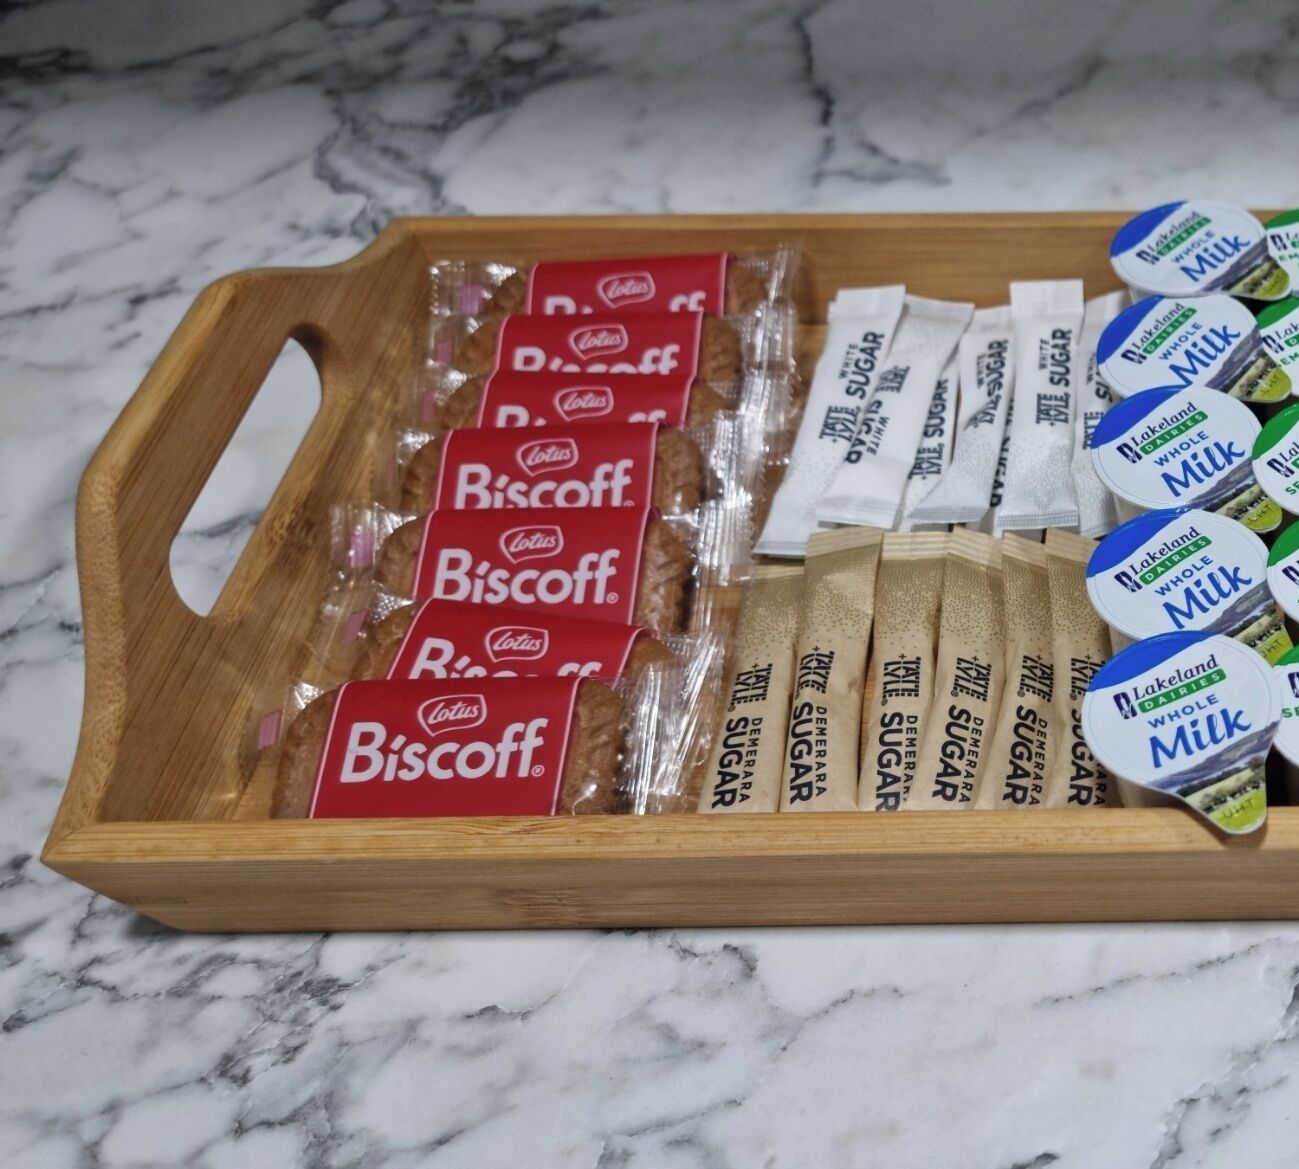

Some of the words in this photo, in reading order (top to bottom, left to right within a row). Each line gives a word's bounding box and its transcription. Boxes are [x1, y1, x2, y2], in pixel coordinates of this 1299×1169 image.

[1148, 211, 1202, 252] Lakeland
[1170, 230, 1217, 264] WHOLE
[1180, 235, 1251, 282] Milk
[607, 277, 650, 300] Lotus
[577, 329, 623, 351] Lotus
[1131, 302, 1186, 351] Lakeland
[1146, 308, 1195, 352] DAIRIES
[1158, 321, 1204, 362] WHOLE
[839, 343, 860, 379] WHITE
[845, 330, 885, 400] SUGAR
[1038, 338, 1050, 371] WHITE
[1048, 328, 1072, 388] SUGAR
[1168, 324, 1241, 386] Milk
[562, 391, 607, 411] Lotus
[1035, 393, 1054, 425] TATE
[866, 415, 891, 456] WHITE
[1131, 402, 1198, 448] Lakeland
[1145, 413, 1205, 453] DAIRIES
[525, 447, 571, 466] Lotus
[1153, 430, 1210, 468] WHOLE
[1160, 441, 1246, 498] Milk
[455, 458, 635, 509] Biscoff
[509, 531, 558, 553] Lotus
[1129, 526, 1202, 577] Lakeland
[1144, 539, 1208, 582] DAIRIES
[1154, 555, 1214, 597] WHOLE
[1162, 565, 1253, 630] Milk
[492, 630, 543, 652] Lotus
[750, 664, 773, 702] TATE
[811, 650, 836, 695] TATE
[900, 656, 921, 698] TATE
[971, 663, 992, 703] TATE
[1036, 663, 1055, 703] TATE
[1132, 653, 1221, 702] Lakeland
[1143, 671, 1222, 711] DAIRIES
[427, 701, 479, 724] Lotus
[1147, 693, 1221, 730] WHOLE
[789, 701, 814, 805] SUGAR
[815, 706, 828, 797] DEMERARA
[931, 704, 972, 802] SUGAR
[958, 716, 985, 803] DEMERARA
[1002, 704, 1038, 806] SUGAR
[1149, 707, 1252, 769] Milk
[712, 716, 750, 809] SUGAR
[739, 717, 763, 804] DEMERARA
[875, 711, 904, 813] SUGAR
[1028, 718, 1049, 806] DEMERARA
